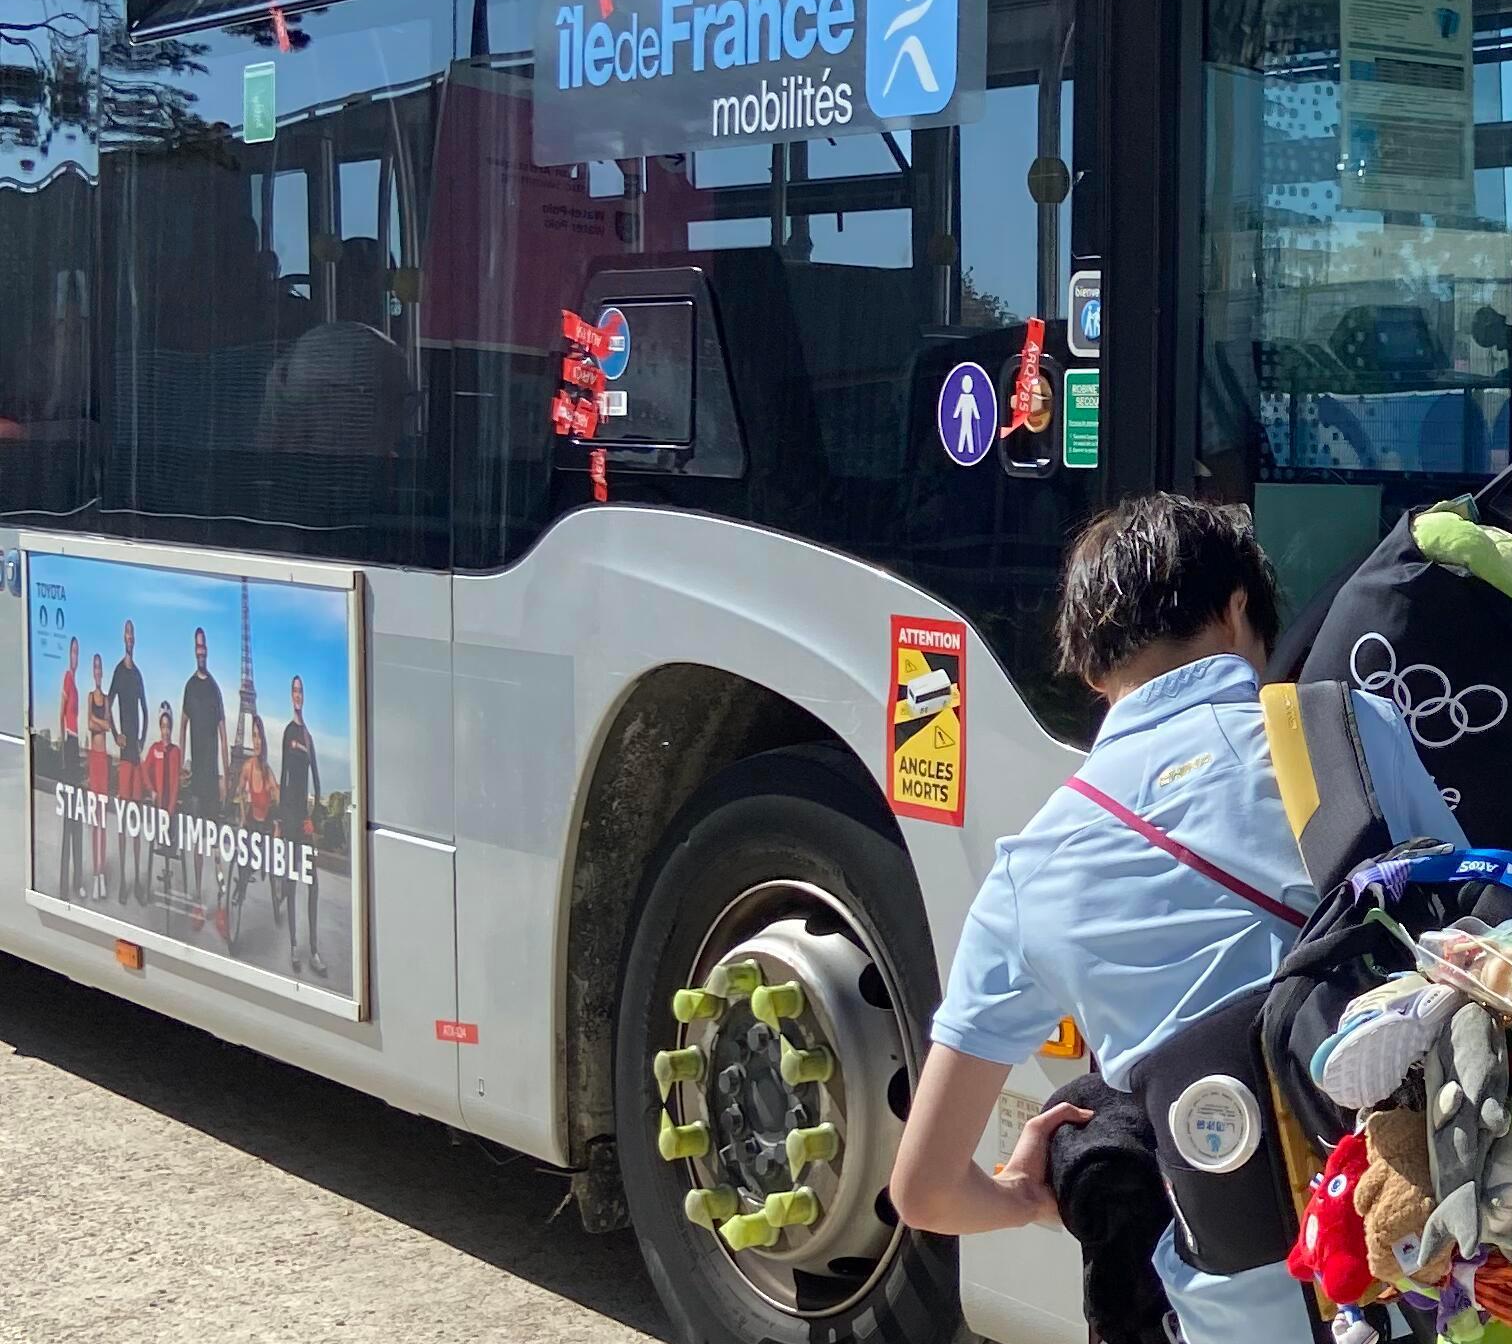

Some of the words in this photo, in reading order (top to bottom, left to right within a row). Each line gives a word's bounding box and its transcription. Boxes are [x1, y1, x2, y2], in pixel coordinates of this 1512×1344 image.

[712, 67, 853, 137] mobilités
[898, 627, 961, 650] ATTENTION
[898, 755, 954, 782] ANGLES
[901, 779, 949, 803] MORTS
[55, 782, 109, 829] START
[114, 797, 171, 847] YOUR
